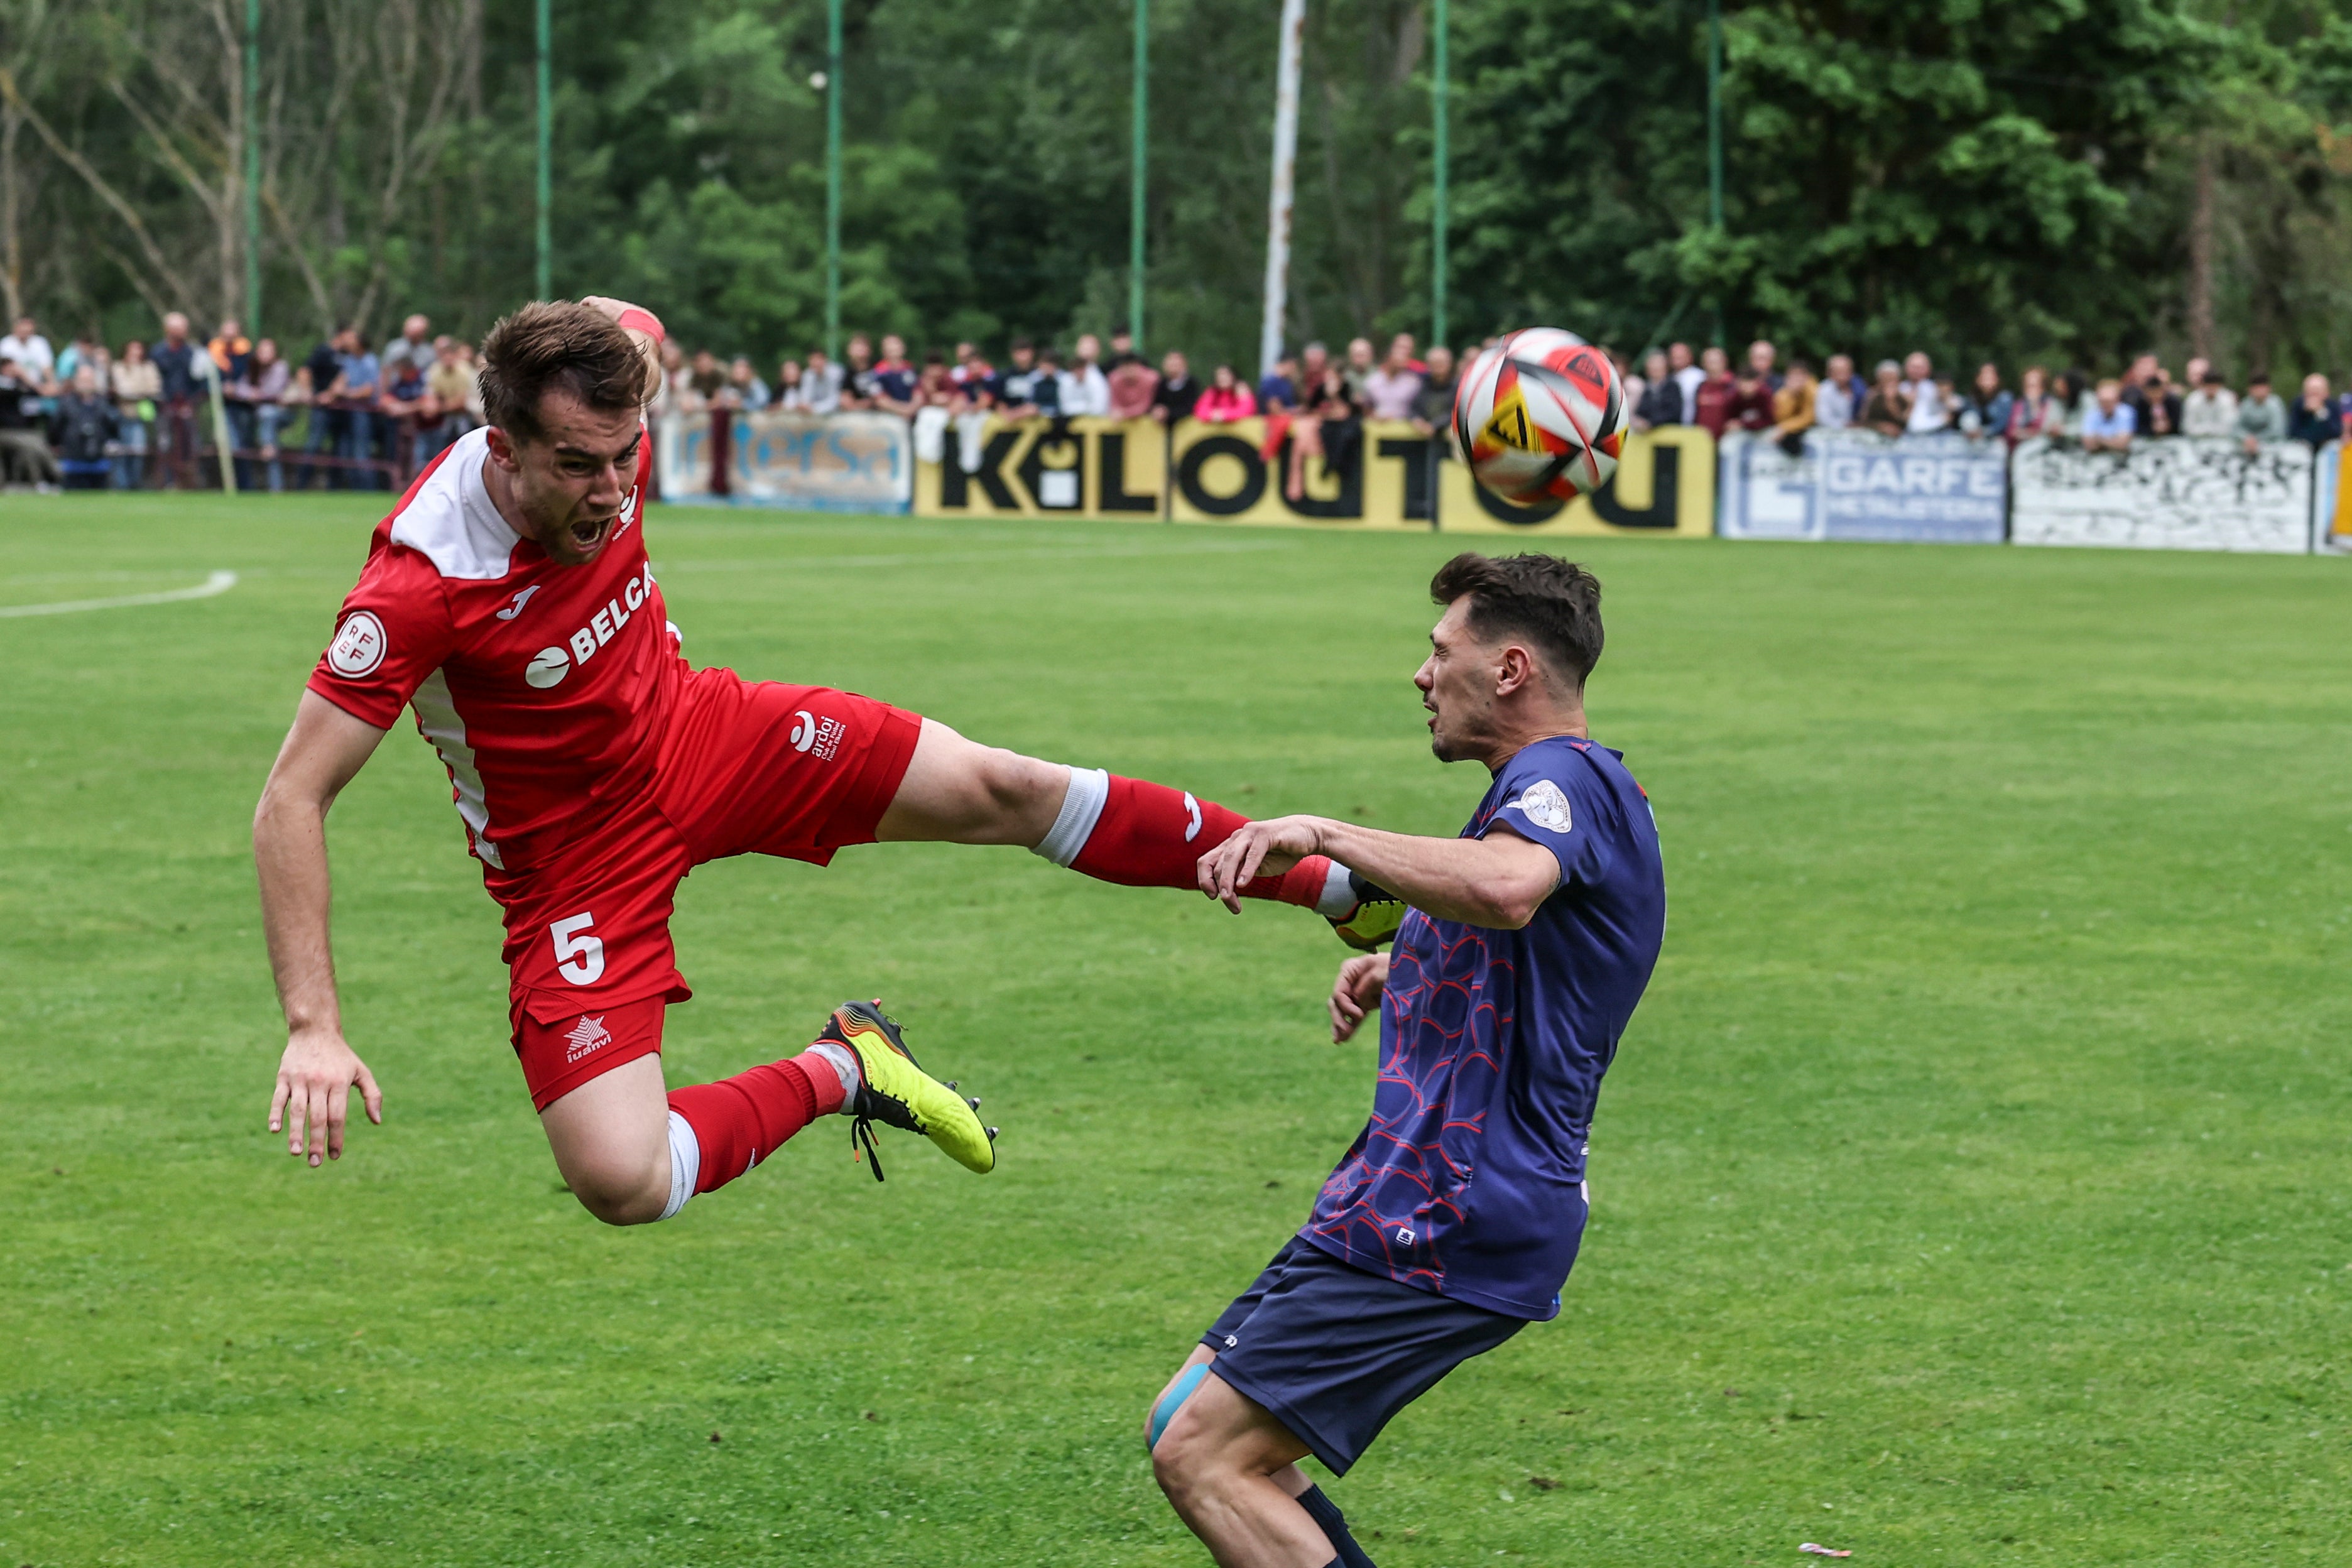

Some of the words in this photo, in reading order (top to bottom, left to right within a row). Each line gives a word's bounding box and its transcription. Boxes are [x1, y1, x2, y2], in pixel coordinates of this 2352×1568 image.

[1827, 457, 1998, 498] GARFE
[812, 716, 835, 758] ardoi
[821, 748, 830, 760] Club
[550, 911, 605, 986] 5
[567, 1033, 612, 1064] luanvi
